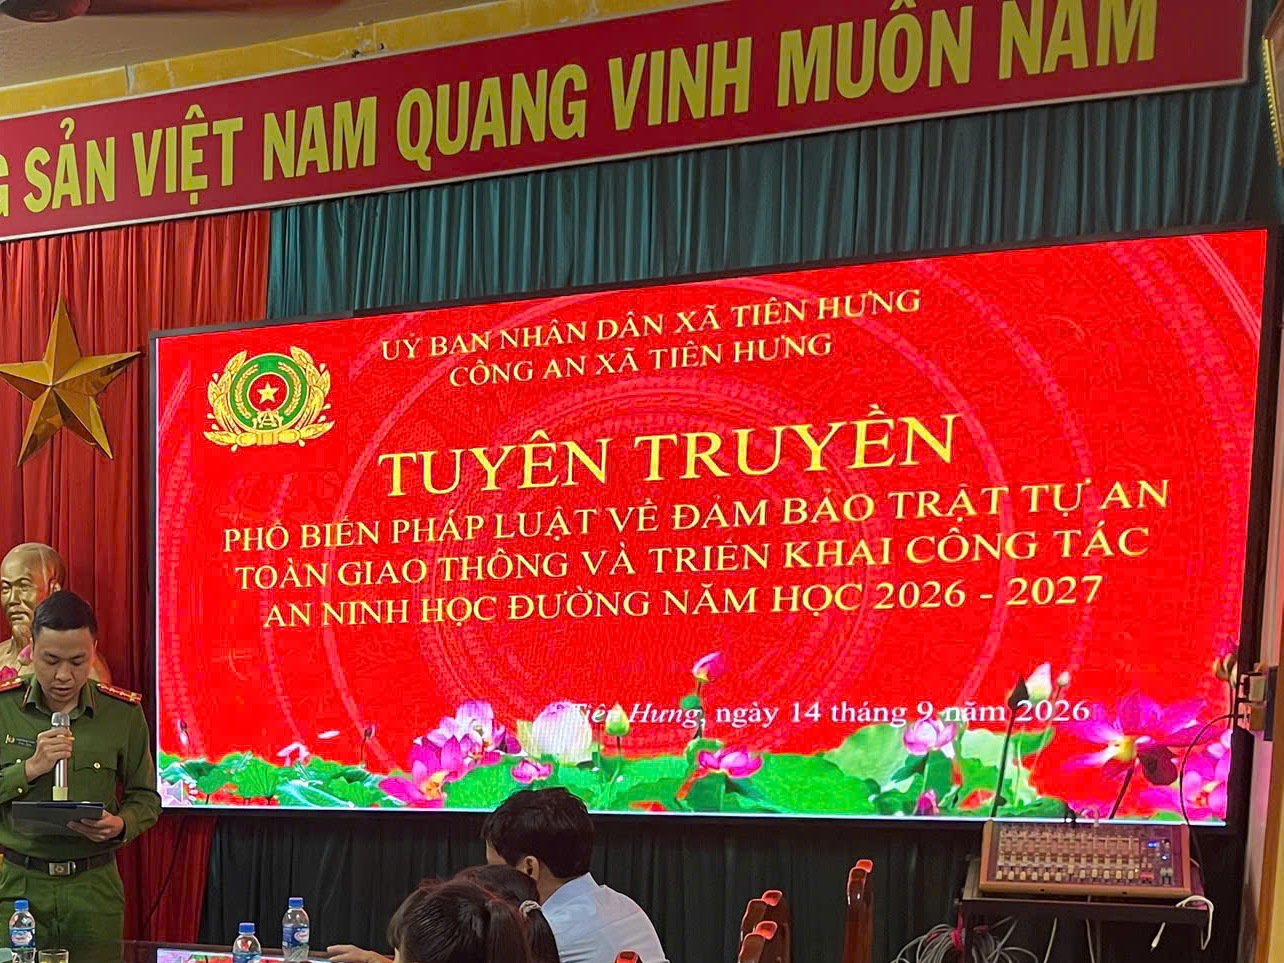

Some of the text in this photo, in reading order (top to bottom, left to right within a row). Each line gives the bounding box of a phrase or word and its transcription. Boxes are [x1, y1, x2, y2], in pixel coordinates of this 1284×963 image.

[24, 116, 116, 213] SẢN
[132, 104, 243, 205] VIỆT
[264, 96, 376, 180] NAM
[397, 64, 587, 171] QUANG
[609, 37, 751, 129] VINH
[778, 0, 972, 106] MUÔN
[431, 332, 490, 356] BAN
[500, 320, 586, 349] NHÂN
[597, 313, 663, 340] DÂN
[676, 304, 720, 333] XÃ
[732, 297, 807, 327] TIÊN
[818, 290, 919, 319] HƯNG
[450, 334, 831, 386] CÔNG AN XÃ TIÊN HƯNG
[378, 404, 961, 496] TUYÊN TRUYỀN
[300, 515, 379, 548] BIẾN
[392, 509, 484, 543] PHÁP
[495, 507, 597, 539] LUẬT
[672, 495, 768, 529] ĐẢM
[782, 488, 874, 524] BẢO
[888, 484, 1009, 522] TRẬT
[1021, 478, 1091, 516] TỰ
[1100, 480, 1168, 509] AN
[235, 558, 328, 589] TOÀN
[338, 559, 427, 586] GIAO
[437, 548, 567, 581] THÔNG
[581, 542, 635, 575] VÀ
[784, 538, 892, 568] KHAI
[907, 527, 1037, 563] CÔNG
[1054, 520, 1148, 557] TÁC
[263, 603, 310, 628] AN
[322, 600, 408, 625] NINH
[420, 596, 496, 626] HỌC
[508, 586, 649, 619] ĐƯỜNG
[662, 582, 757, 615] NĂM
[772, 583, 862, 616] HỌC
[874, 580, 965, 609] 2026
[1006, 576, 1102, 605] 2027
[716, 701, 779, 727] ngày
[791, 701, 822, 722] 14
[831, 701, 907, 727] tháng
[916, 700, 934, 722] 9
[944, 702, 1006, 722] năm
[1015, 699, 1091, 722] 2026
